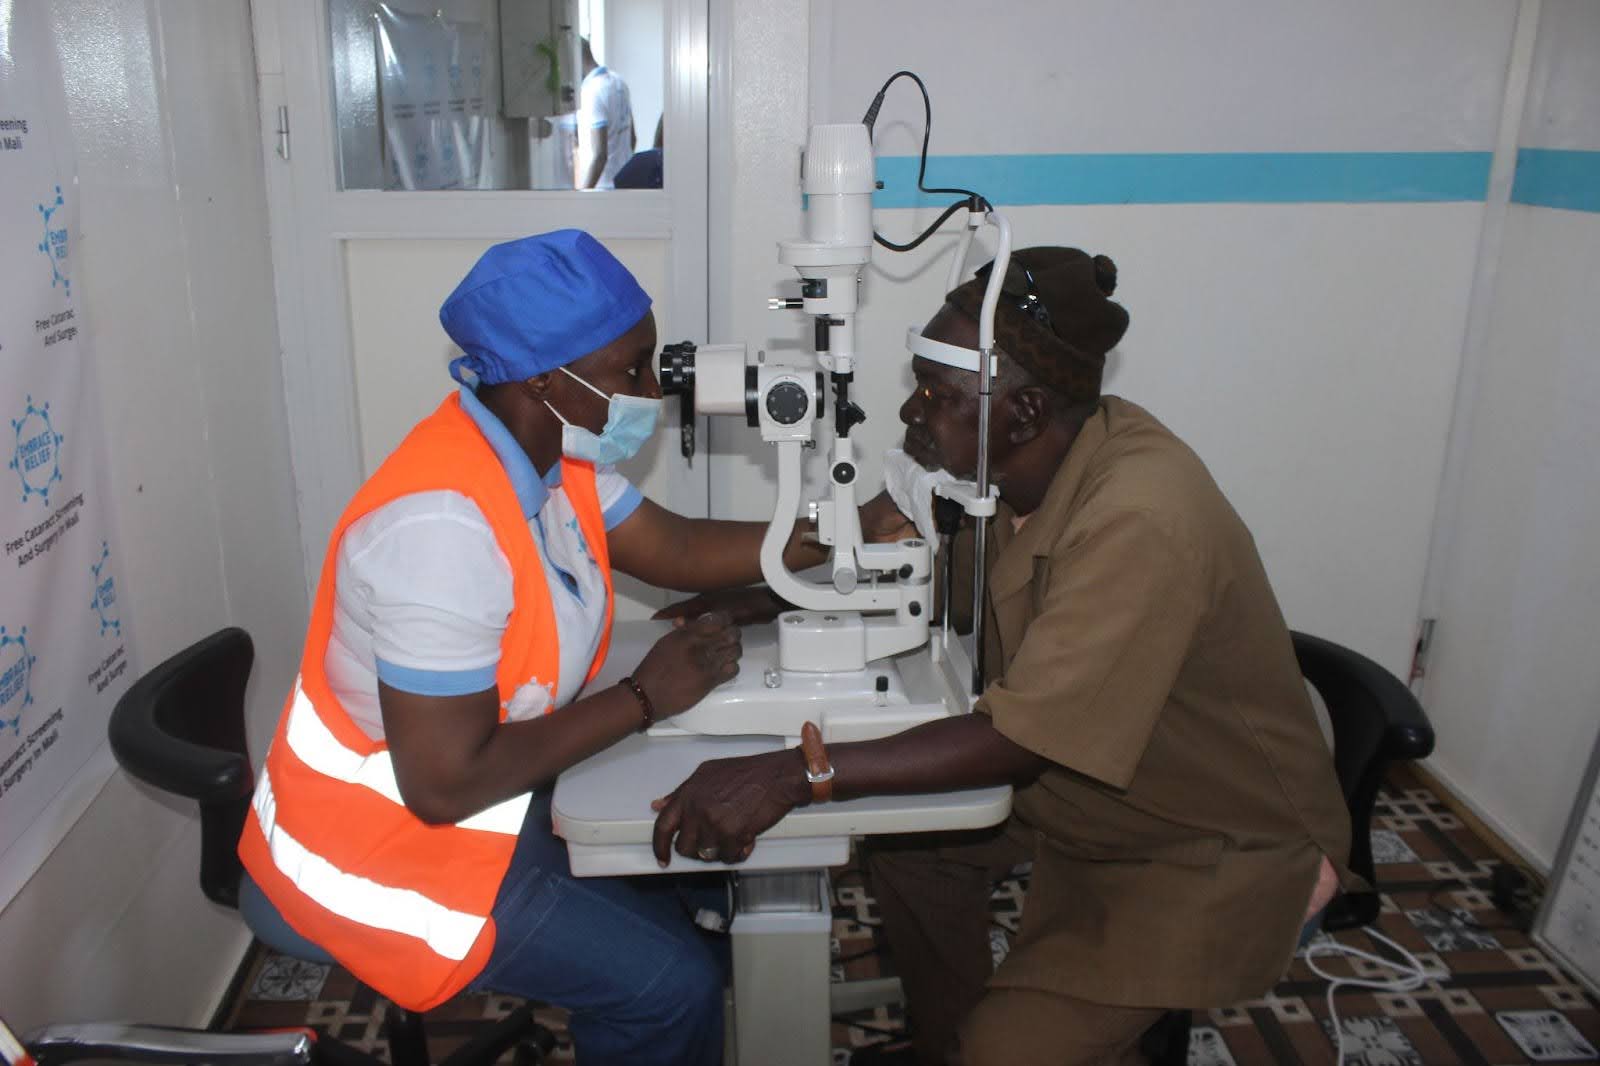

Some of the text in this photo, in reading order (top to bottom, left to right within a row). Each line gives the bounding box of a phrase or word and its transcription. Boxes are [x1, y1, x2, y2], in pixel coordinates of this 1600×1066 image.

[36, 319, 50, 332] Free
[19, 431, 51, 459] EMBRACE
[24, 447, 50, 472] RELIEF
[6, 493, 84, 556] Free Cataract Screening
[18, 547, 34, 569] And
[34, 531, 59, 556] Surgery
[65, 511, 80, 530] Mali
[88, 667, 101, 685] Free
[26, 707, 64, 748] Screening
[3, 756, 33, 793] Surgery
[42, 727, 59, 751] Mali
